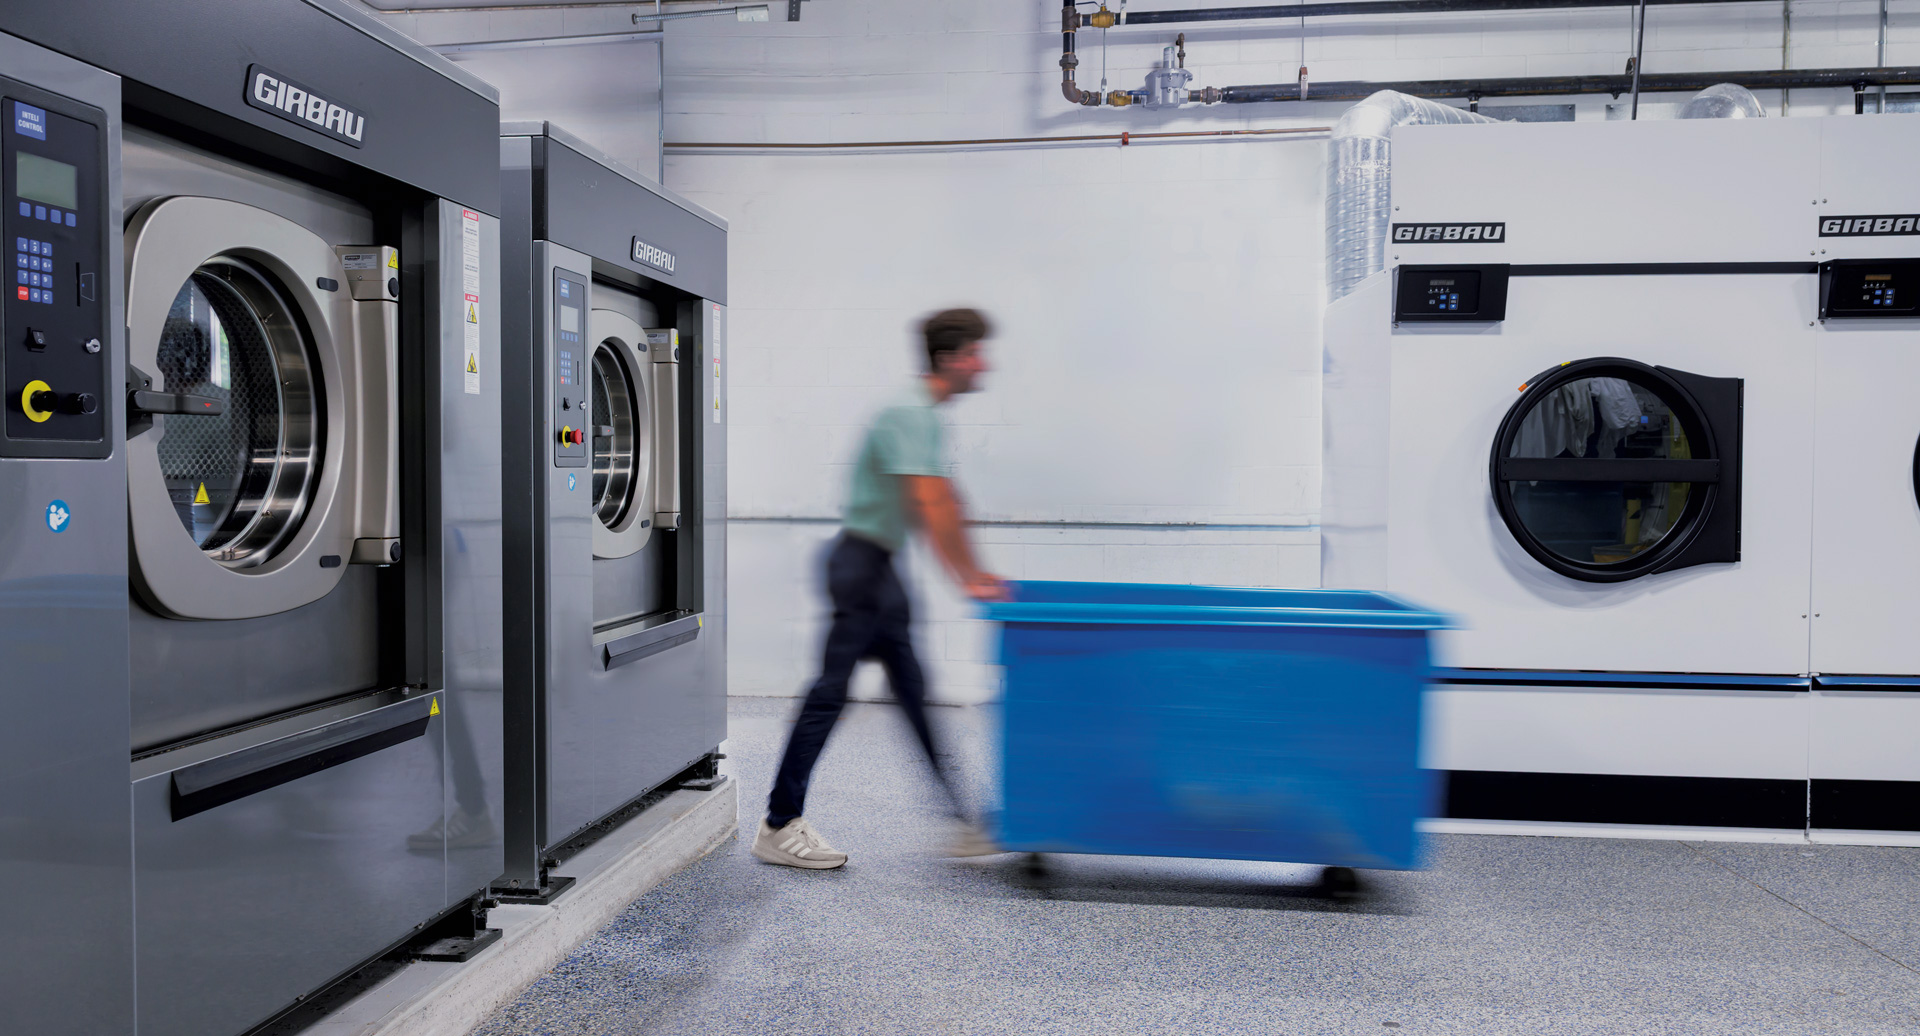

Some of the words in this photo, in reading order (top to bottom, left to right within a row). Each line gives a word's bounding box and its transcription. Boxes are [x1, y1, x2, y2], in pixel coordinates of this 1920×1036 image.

[254, 73, 364, 142] GIRBAU
[22, 111, 39, 122] INTELI
[18, 119, 43, 133] CONTROL
[1821, 218, 1920, 233] GIRBA
[1394, 226, 1503, 240] GIRBAU
[635, 240, 676, 272] GIRBAU
